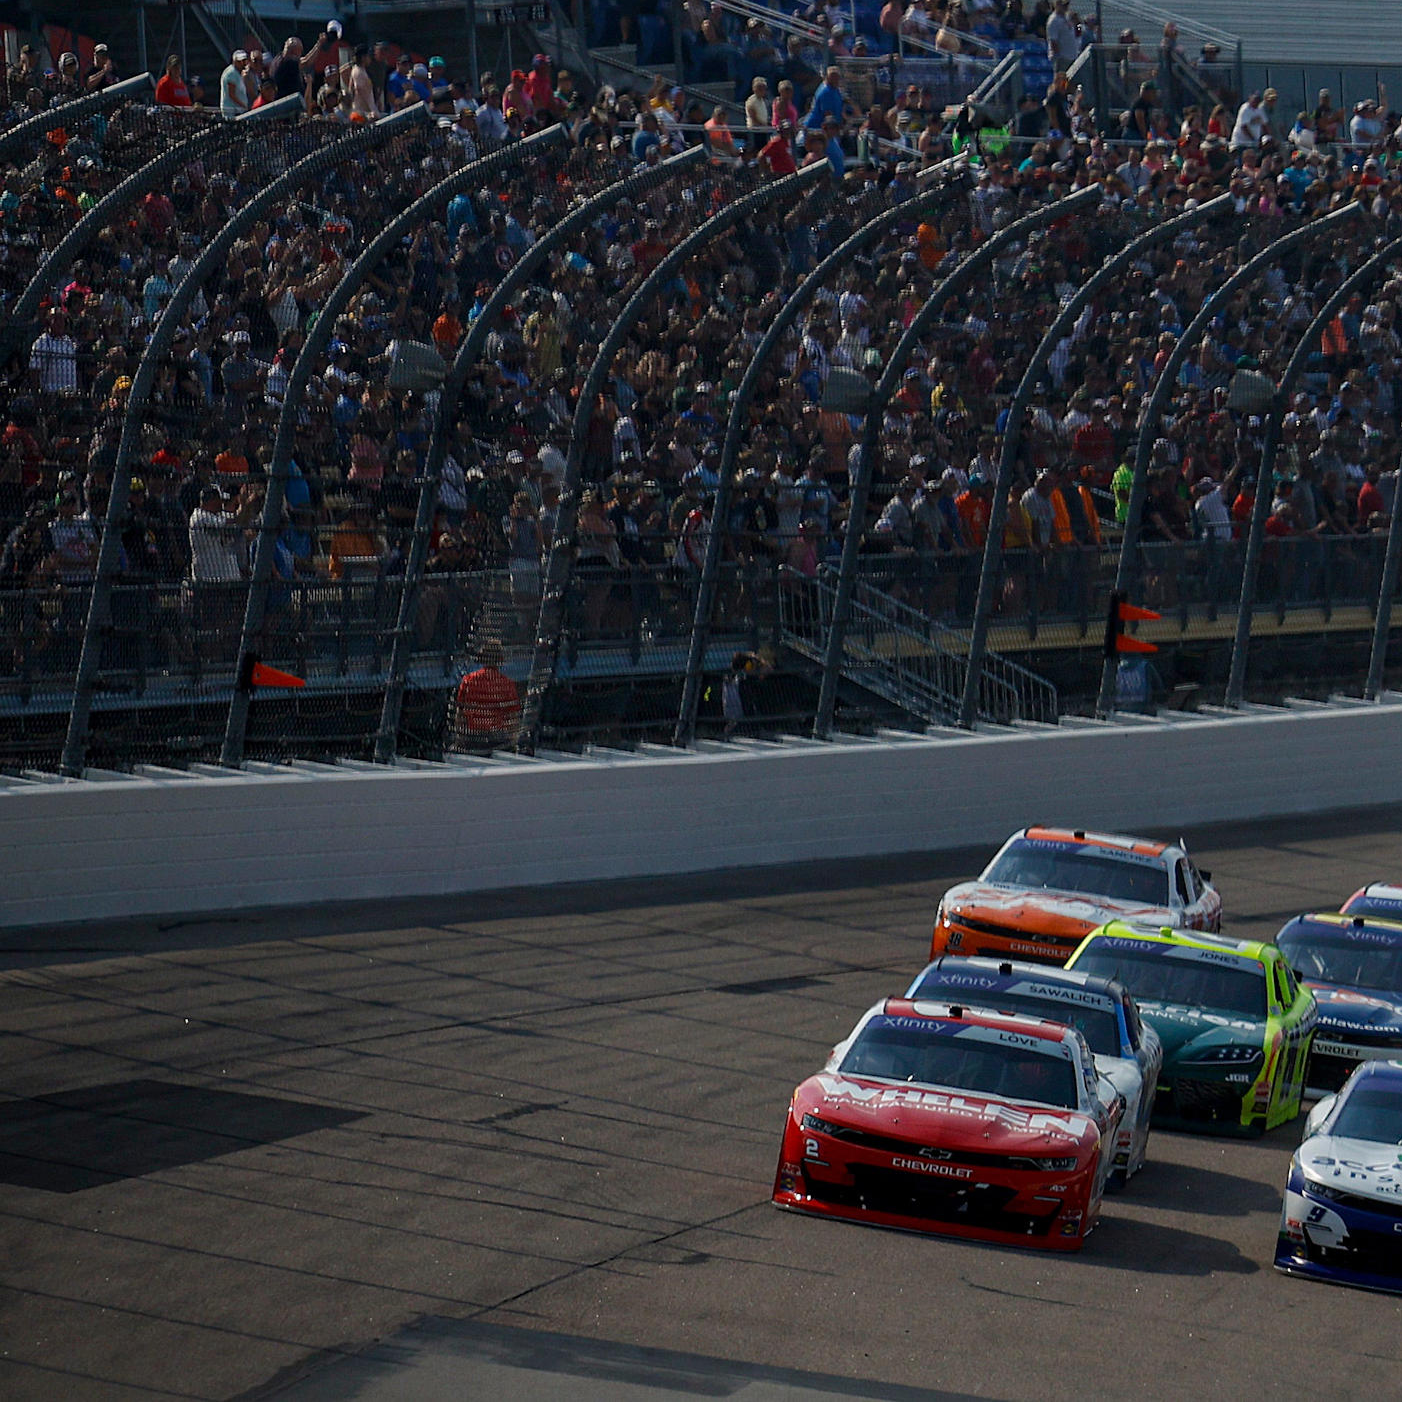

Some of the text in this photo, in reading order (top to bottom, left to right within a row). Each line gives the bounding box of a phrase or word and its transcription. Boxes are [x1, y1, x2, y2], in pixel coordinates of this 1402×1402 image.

[1101, 937, 1157, 951] xfinity
[1346, 930, 1396, 945] xfinity
[1200, 951, 1239, 965] JONES
[938, 974, 998, 989] xfinity
[1029, 985, 1101, 1005] SAWALICH
[882, 1017, 948, 1031] xfinity
[1316, 1016, 1400, 1033] hlaw.com
[999, 1033, 1038, 1048] LOVE
[1315, 1043, 1361, 1058] VROLET
[816, 1077, 1089, 1138] WHELEN
[823, 1095, 1081, 1145] MANUFACTURED IN AMERICA
[805, 1139, 819, 1157] 2
[891, 1157, 974, 1179] CHEVROLET
[1307, 1206, 1327, 1223] 9
